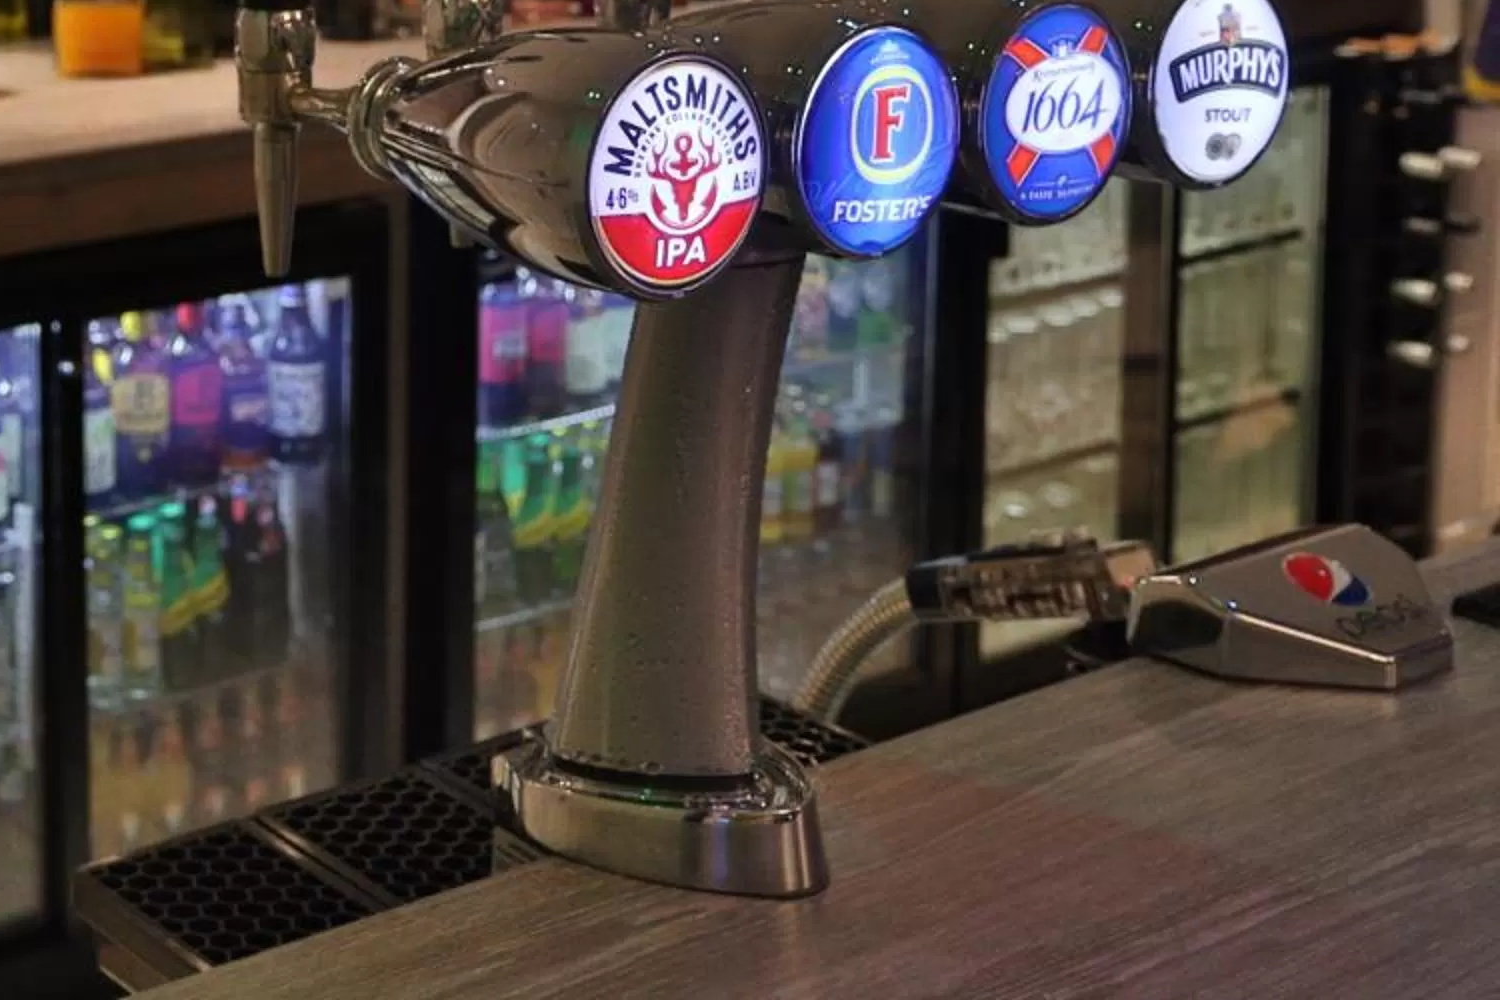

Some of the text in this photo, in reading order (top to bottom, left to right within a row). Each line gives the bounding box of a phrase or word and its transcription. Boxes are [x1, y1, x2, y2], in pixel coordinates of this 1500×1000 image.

[603, 73, 758, 178] MALTSMITHS
[871, 83, 910, 162] F
[1022, 75, 1107, 134] 1664
[1204, 108, 1253, 123] STOUT
[732, 167, 758, 193] ABV
[655, 236, 707, 269] IPA
